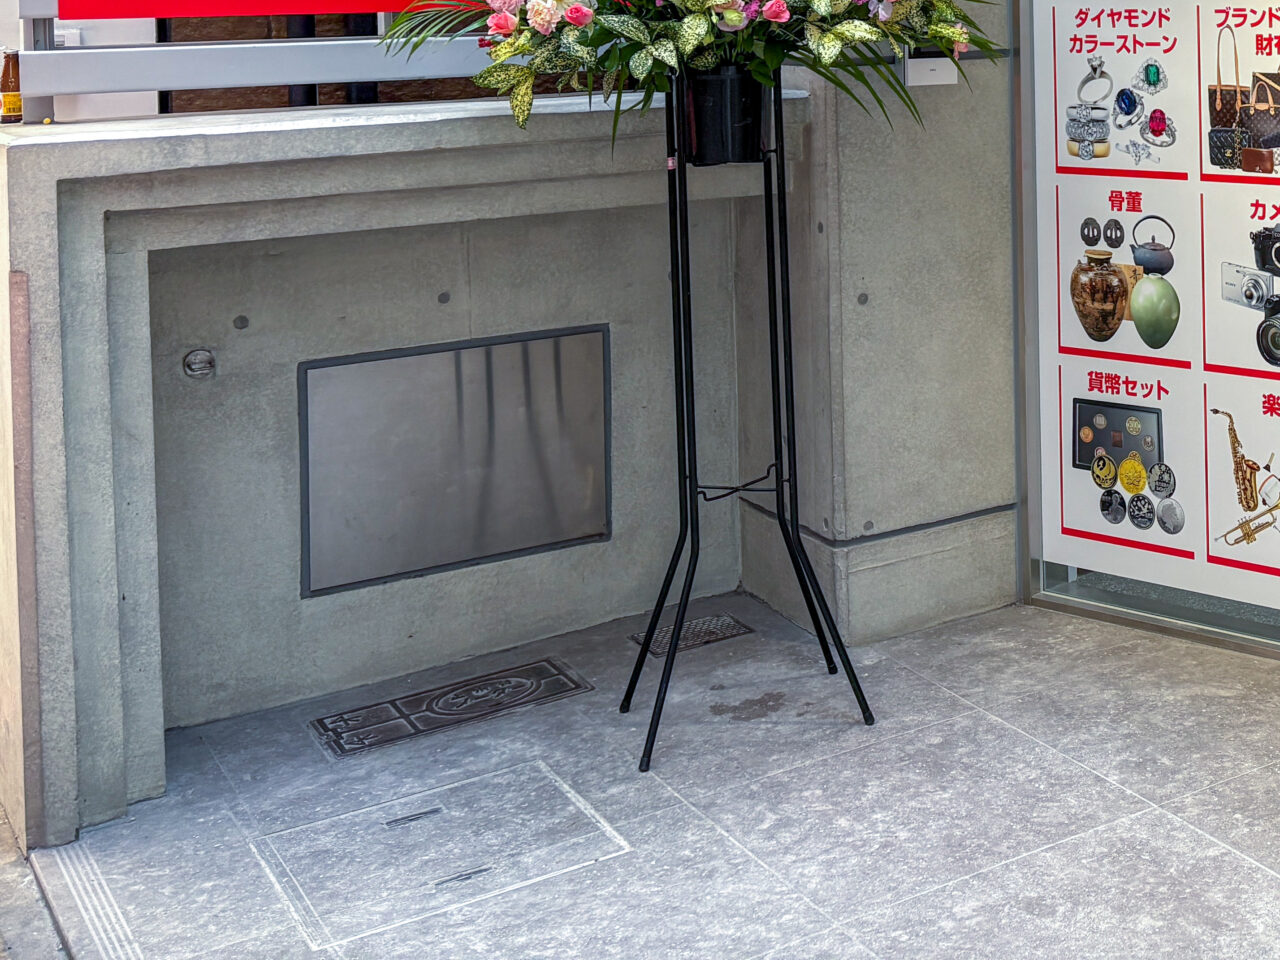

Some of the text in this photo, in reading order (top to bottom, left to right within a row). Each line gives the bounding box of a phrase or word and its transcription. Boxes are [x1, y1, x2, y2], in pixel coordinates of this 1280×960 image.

[1075, 8, 1171, 29] ダイヤモンド
[1069, 34, 1178, 55] カラーストーン
[1108, 190, 1143, 214] 骨董
[1087, 370, 1170, 401] 貨幣セット
